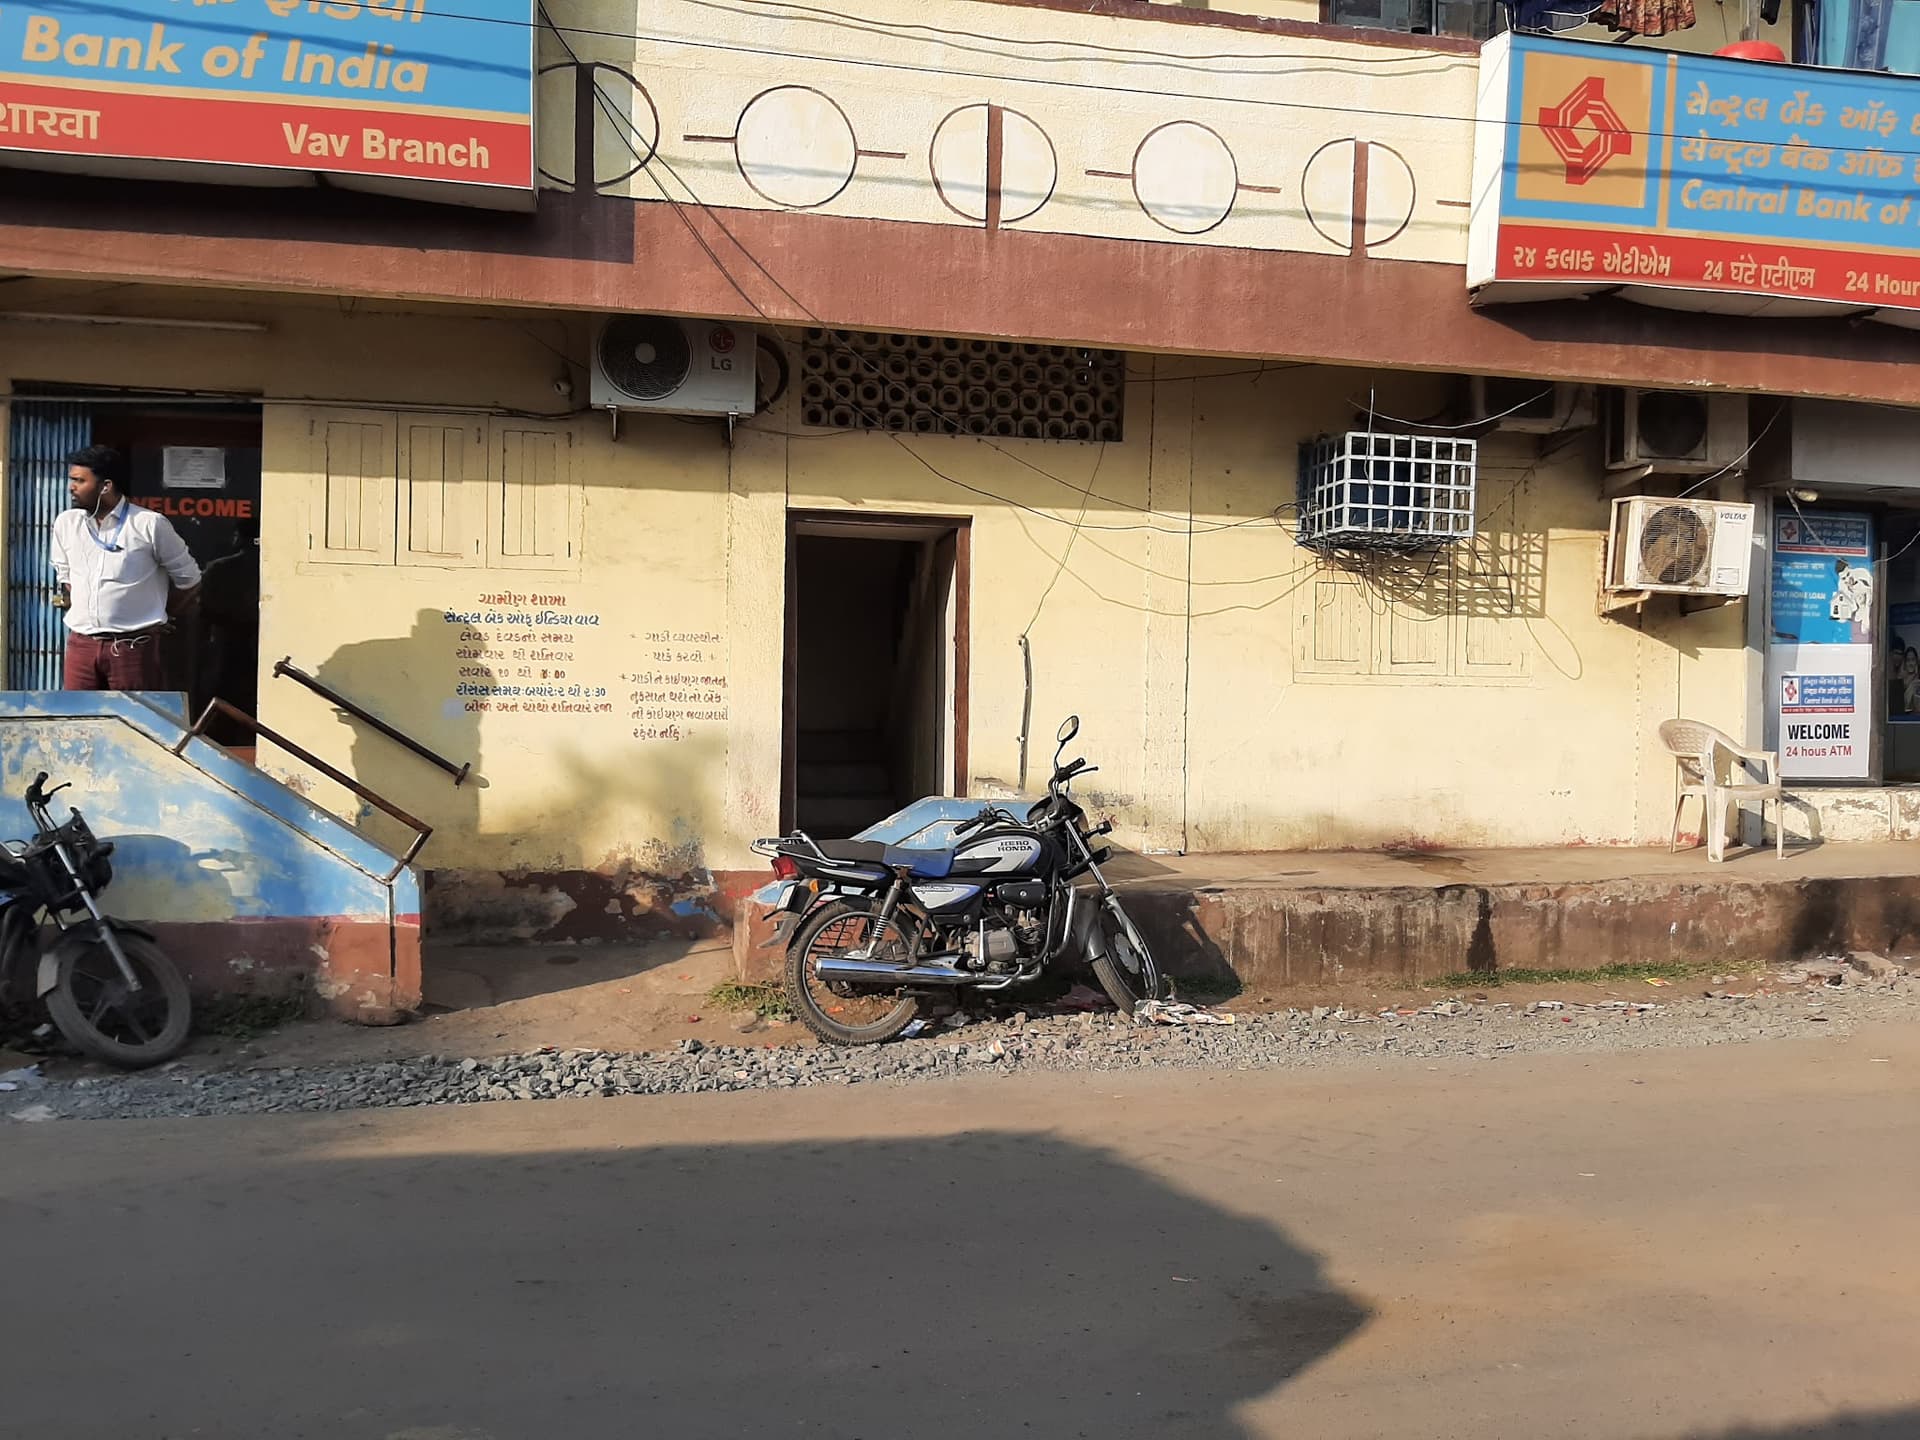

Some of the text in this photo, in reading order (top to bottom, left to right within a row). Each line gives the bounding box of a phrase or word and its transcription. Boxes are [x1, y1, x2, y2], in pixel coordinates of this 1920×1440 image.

[22, 15, 429, 93] Bank of India
[281, 122, 490, 169] Vav Branch
[1781, 132, 1834, 171] बैंक
[1680, 178, 1914, 225] Central Bank of
[1545, 247, 1595, 272] કલાક
[1602, 242, 1671, 277] એટીએમ
[1703, 254, 1816, 290] 24 घंटे एटीएम
[1845, 270, 1869, 292] 24
[711, 356, 732, 371] LG
[1720, 512, 1747, 520] VOLTAS
[1788, 724, 1850, 740] WELCOME
[1786, 745, 1852, 757] 24 hous ATM
